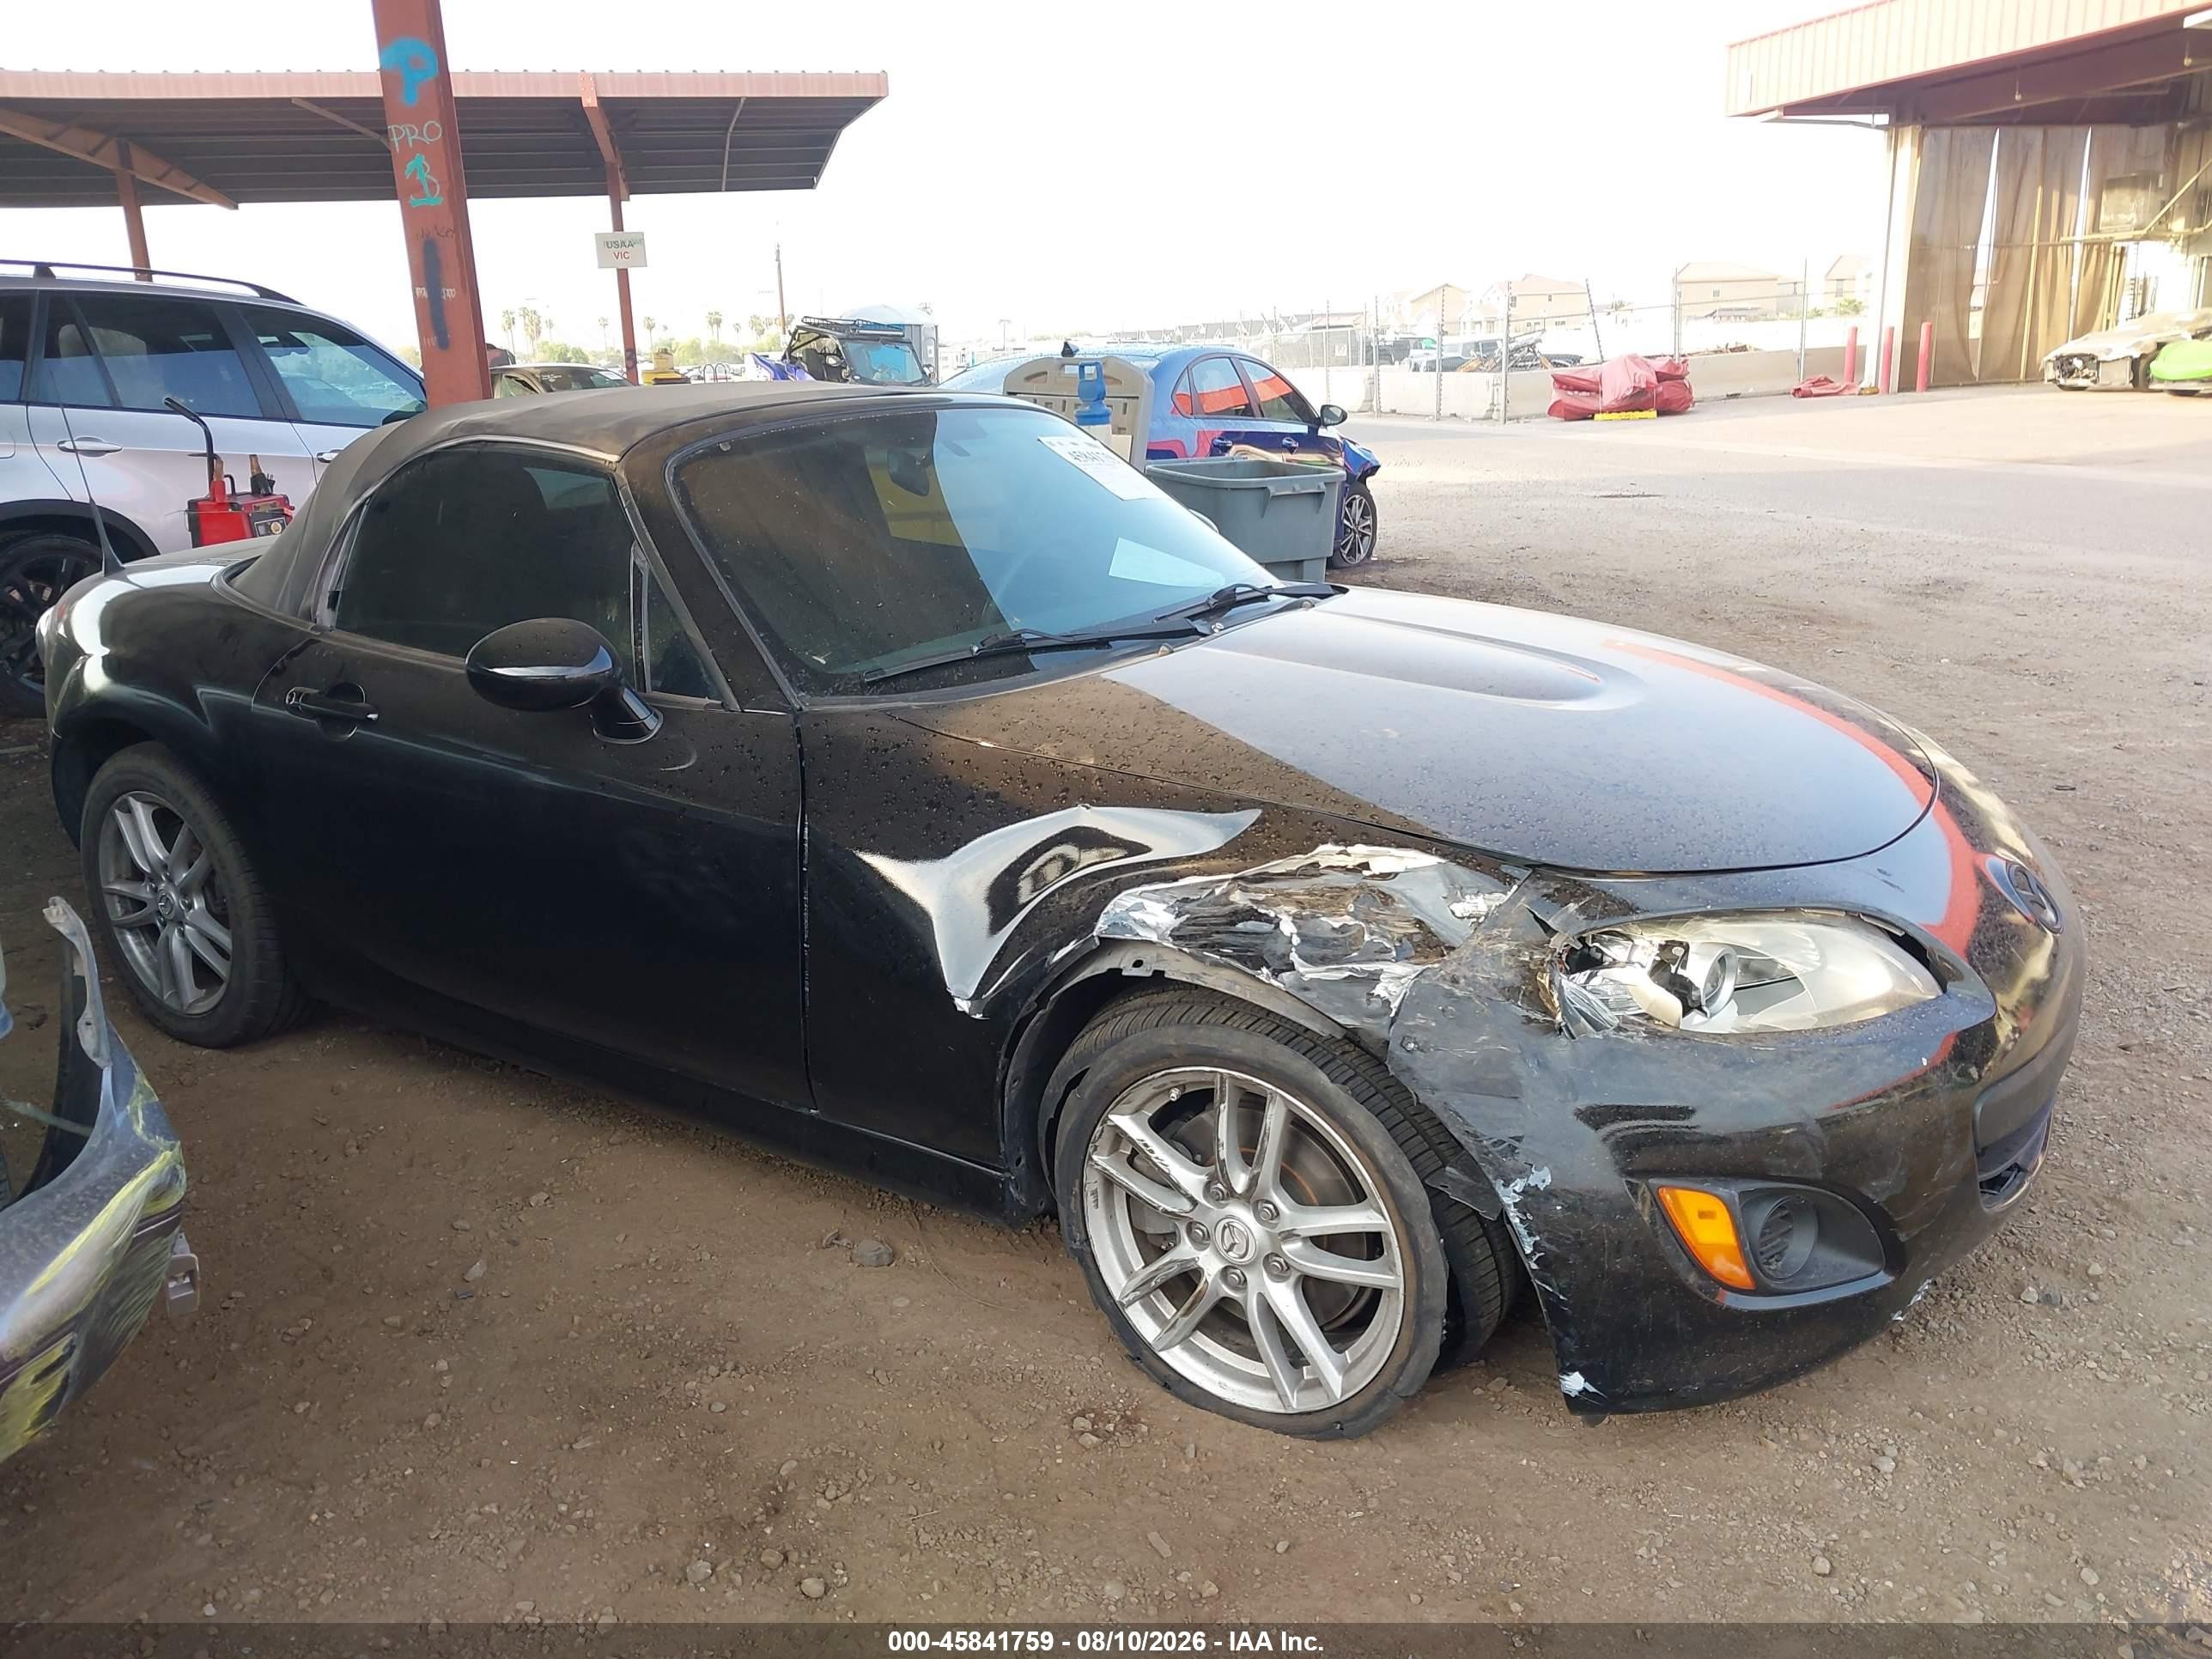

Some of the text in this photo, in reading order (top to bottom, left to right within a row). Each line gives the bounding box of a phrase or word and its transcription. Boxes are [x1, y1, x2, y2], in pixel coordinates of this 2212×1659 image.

[380, 37, 439, 106] P
[388, 120, 442, 154] PRO
[605, 240, 635, 249] USAA
[613, 252, 630, 260] VIC
